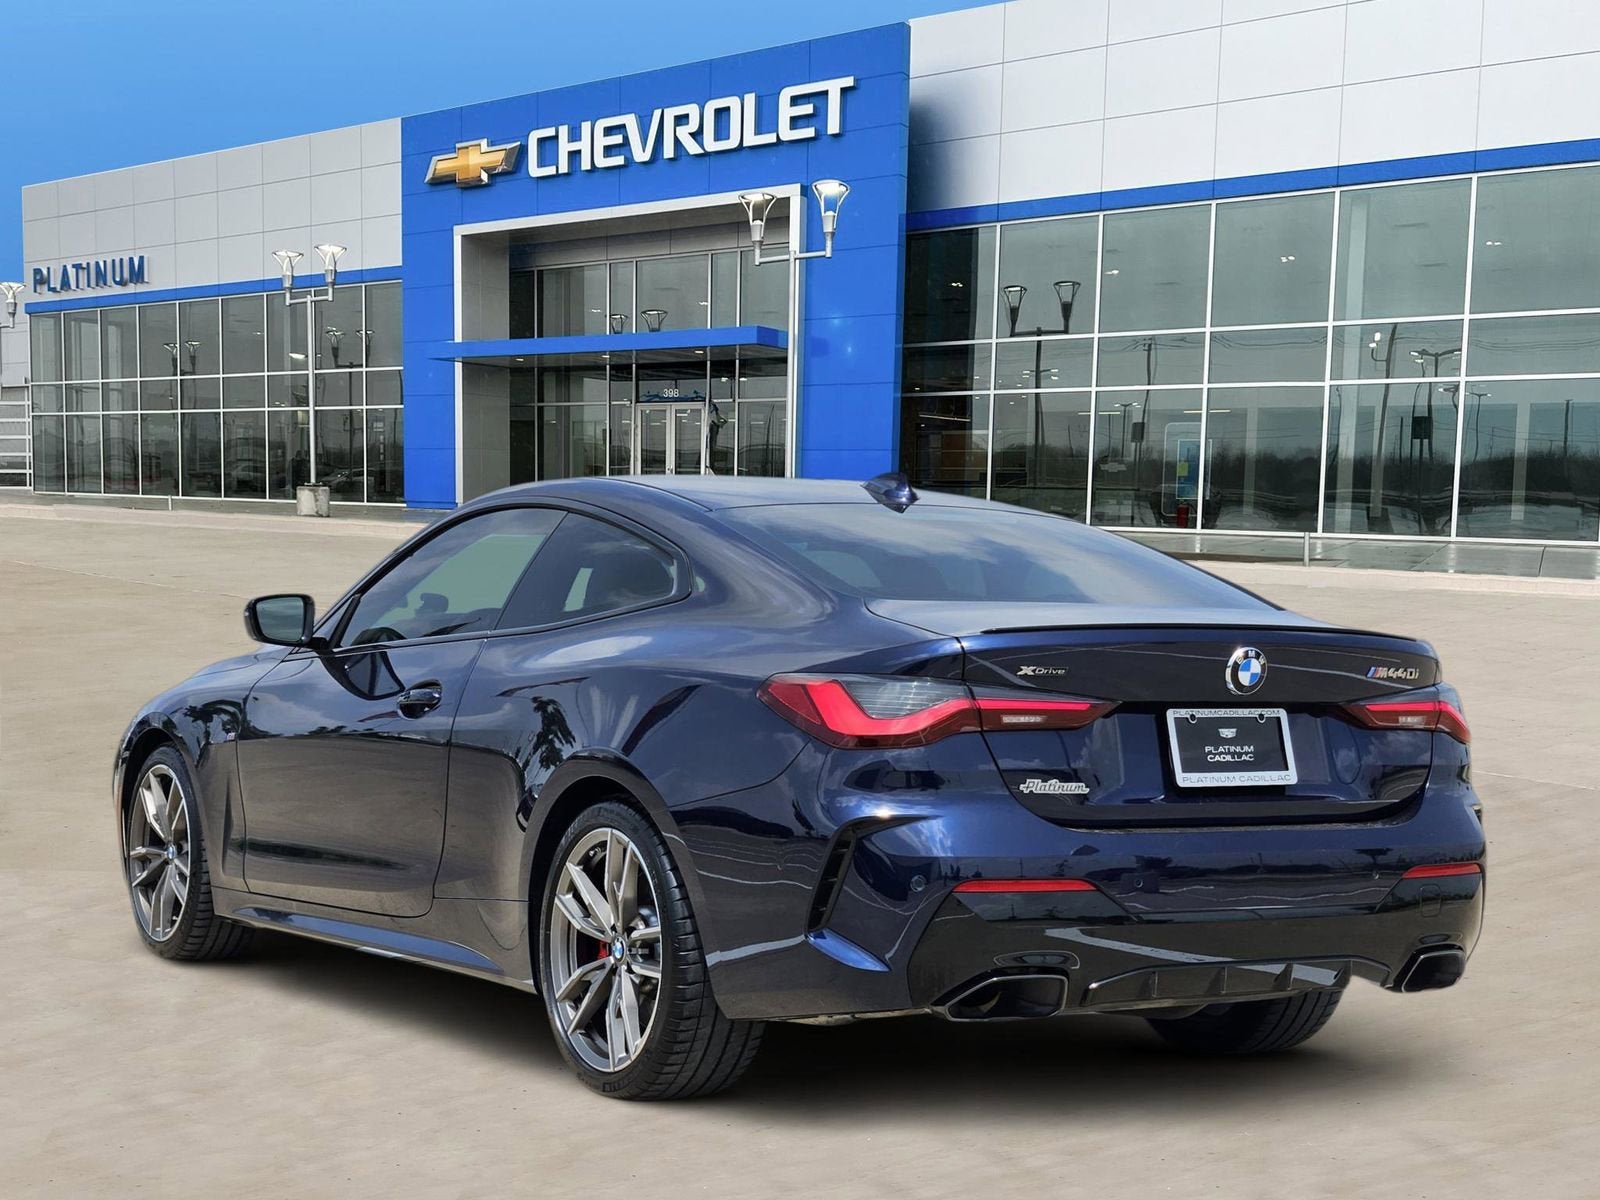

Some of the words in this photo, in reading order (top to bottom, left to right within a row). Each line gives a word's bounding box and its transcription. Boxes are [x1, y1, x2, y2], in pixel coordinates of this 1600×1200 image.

[527, 76, 855, 178] CHEVROLET
[33, 255, 146, 293] PLATINUM
[663, 388, 679, 398] 398
[1374, 666, 1420, 680] M440i
[1207, 754, 1254, 762] CADILLAC
[1020, 779, 1089, 793] Platinum
[1182, 775, 1237, 784] PLATINUM
[1238, 774, 1291, 783] CADILLAC
